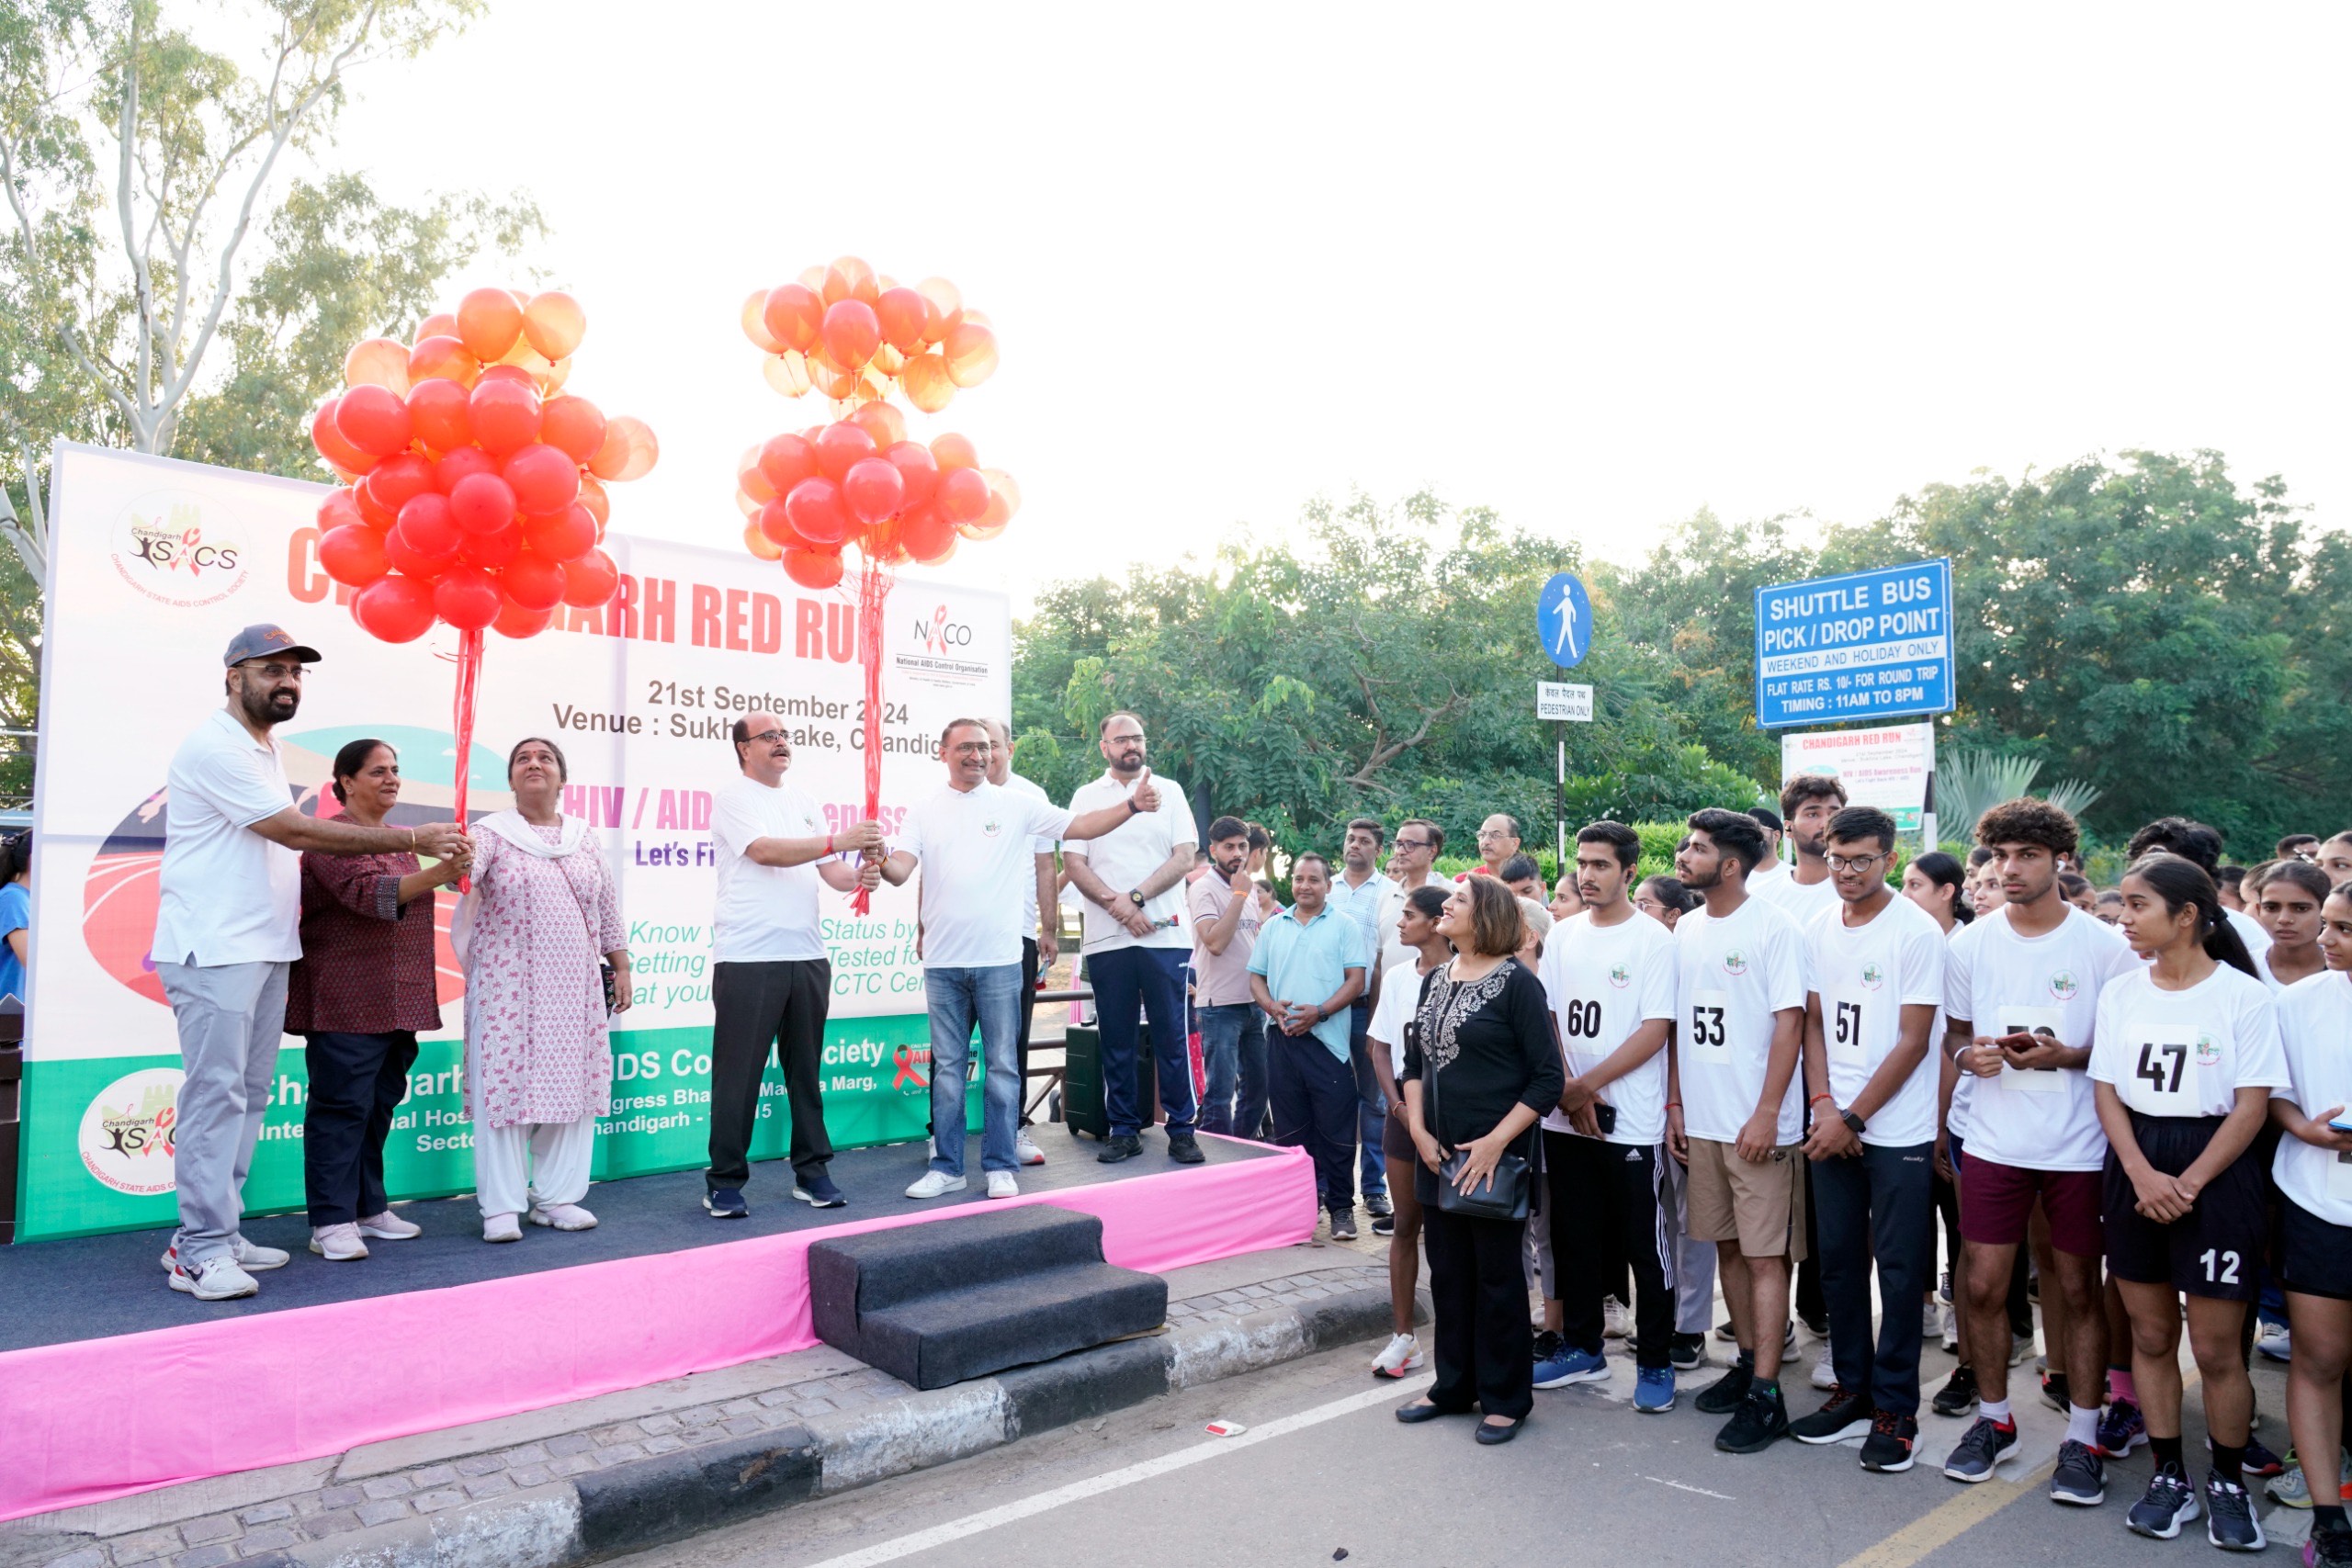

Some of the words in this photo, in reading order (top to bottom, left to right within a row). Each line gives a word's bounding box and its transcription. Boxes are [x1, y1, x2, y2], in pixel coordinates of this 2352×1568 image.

[131, 527, 182, 541] Chandigarh
[111, 553, 147, 594] CHANDIGARH
[146, 591, 170, 605] STATE
[172, 599, 191, 607] AIDS
[194, 592, 229, 607] CONTROL
[227, 570, 250, 595] SOCIETY
[1770, 586, 1869, 621] SHUTTLE
[1883, 577, 1931, 605] BUS
[692, 583, 781, 654] RED
[1765, 626, 1807, 651] PICK
[1811, 624, 1816, 646] /
[1821, 616, 1874, 645] DROP
[1880, 607, 1939, 637] POINT
[896, 657, 919, 666] National
[921, 660, 933, 668] AIDS
[934, 661, 954, 670] Control
[955, 663, 988, 674] Organisation
[1767, 656, 1818, 673] WEEKEND
[1825, 653, 1847, 667] AND
[1853, 646, 1902, 663] HOLIDAY
[1907, 641, 1939, 656] ONLY
[1545, 685, 1559, 697] केवल
[1768, 682, 1788, 696] FLAT
[1792, 680, 1814, 694] RATE
[1817, 678, 1832, 691] RS.
[1837, 675, 1851, 689] 10/-
[1855, 672, 1874, 686] FOR
[1879, 669, 1912, 684] ROUND
[1916, 666, 1939, 680] TRIP
[648, 680, 706, 708] 21st
[714, 685, 849, 720] September
[856, 700, 909, 725] 224
[1541, 704, 1575, 716] PEDESTRIAN
[1577, 705, 1590, 716] ONLY
[1781, 698, 1825, 713] TIMING
[1836, 694, 1869, 707] 11AM
[1873, 691, 1892, 704] TO
[1895, 687, 1923, 702] 8PM
[553, 704, 642, 735] Venue
[670, 713, 734, 740] Sukh
[791, 725, 842, 752] ake,
[850, 728, 941, 761] Candig
[1803, 736, 1860, 750] CHANDIGARH
[1863, 734, 1880, 744] RED
[1883, 732, 1901, 743] RUN
[563, 784, 625, 828] HIV
[632, 787, 650, 829] /
[656, 789, 713, 830] AID
[636, 840, 689, 866] Let's
[628, 920, 701, 943] Know
[820, 919, 887, 940] Status
[894, 919, 919, 943] by
[827, 945, 897, 967] Tested
[632, 982, 657, 1005] at
[663, 985, 713, 1009] you
[1567, 998, 1601, 1039] 60
[1693, 1006, 1725, 1046] 53
[1836, 1001, 1860, 1045] 51
[610, 1051, 661, 1081] IDS
[821, 1038, 885, 1067] ciety
[2136, 1043, 2188, 1093] 47
[612, 1093, 667, 1115] gress
[831, 1076, 876, 1091] Marg,
[102, 1118, 154, 1129] Chandigarh
[82, 1151, 119, 1188] CHANDIGARH
[119, 1182, 144, 1192] STATE
[146, 1183, 166, 1192] AIDS
[2199, 1248, 2241, 1284] 12
